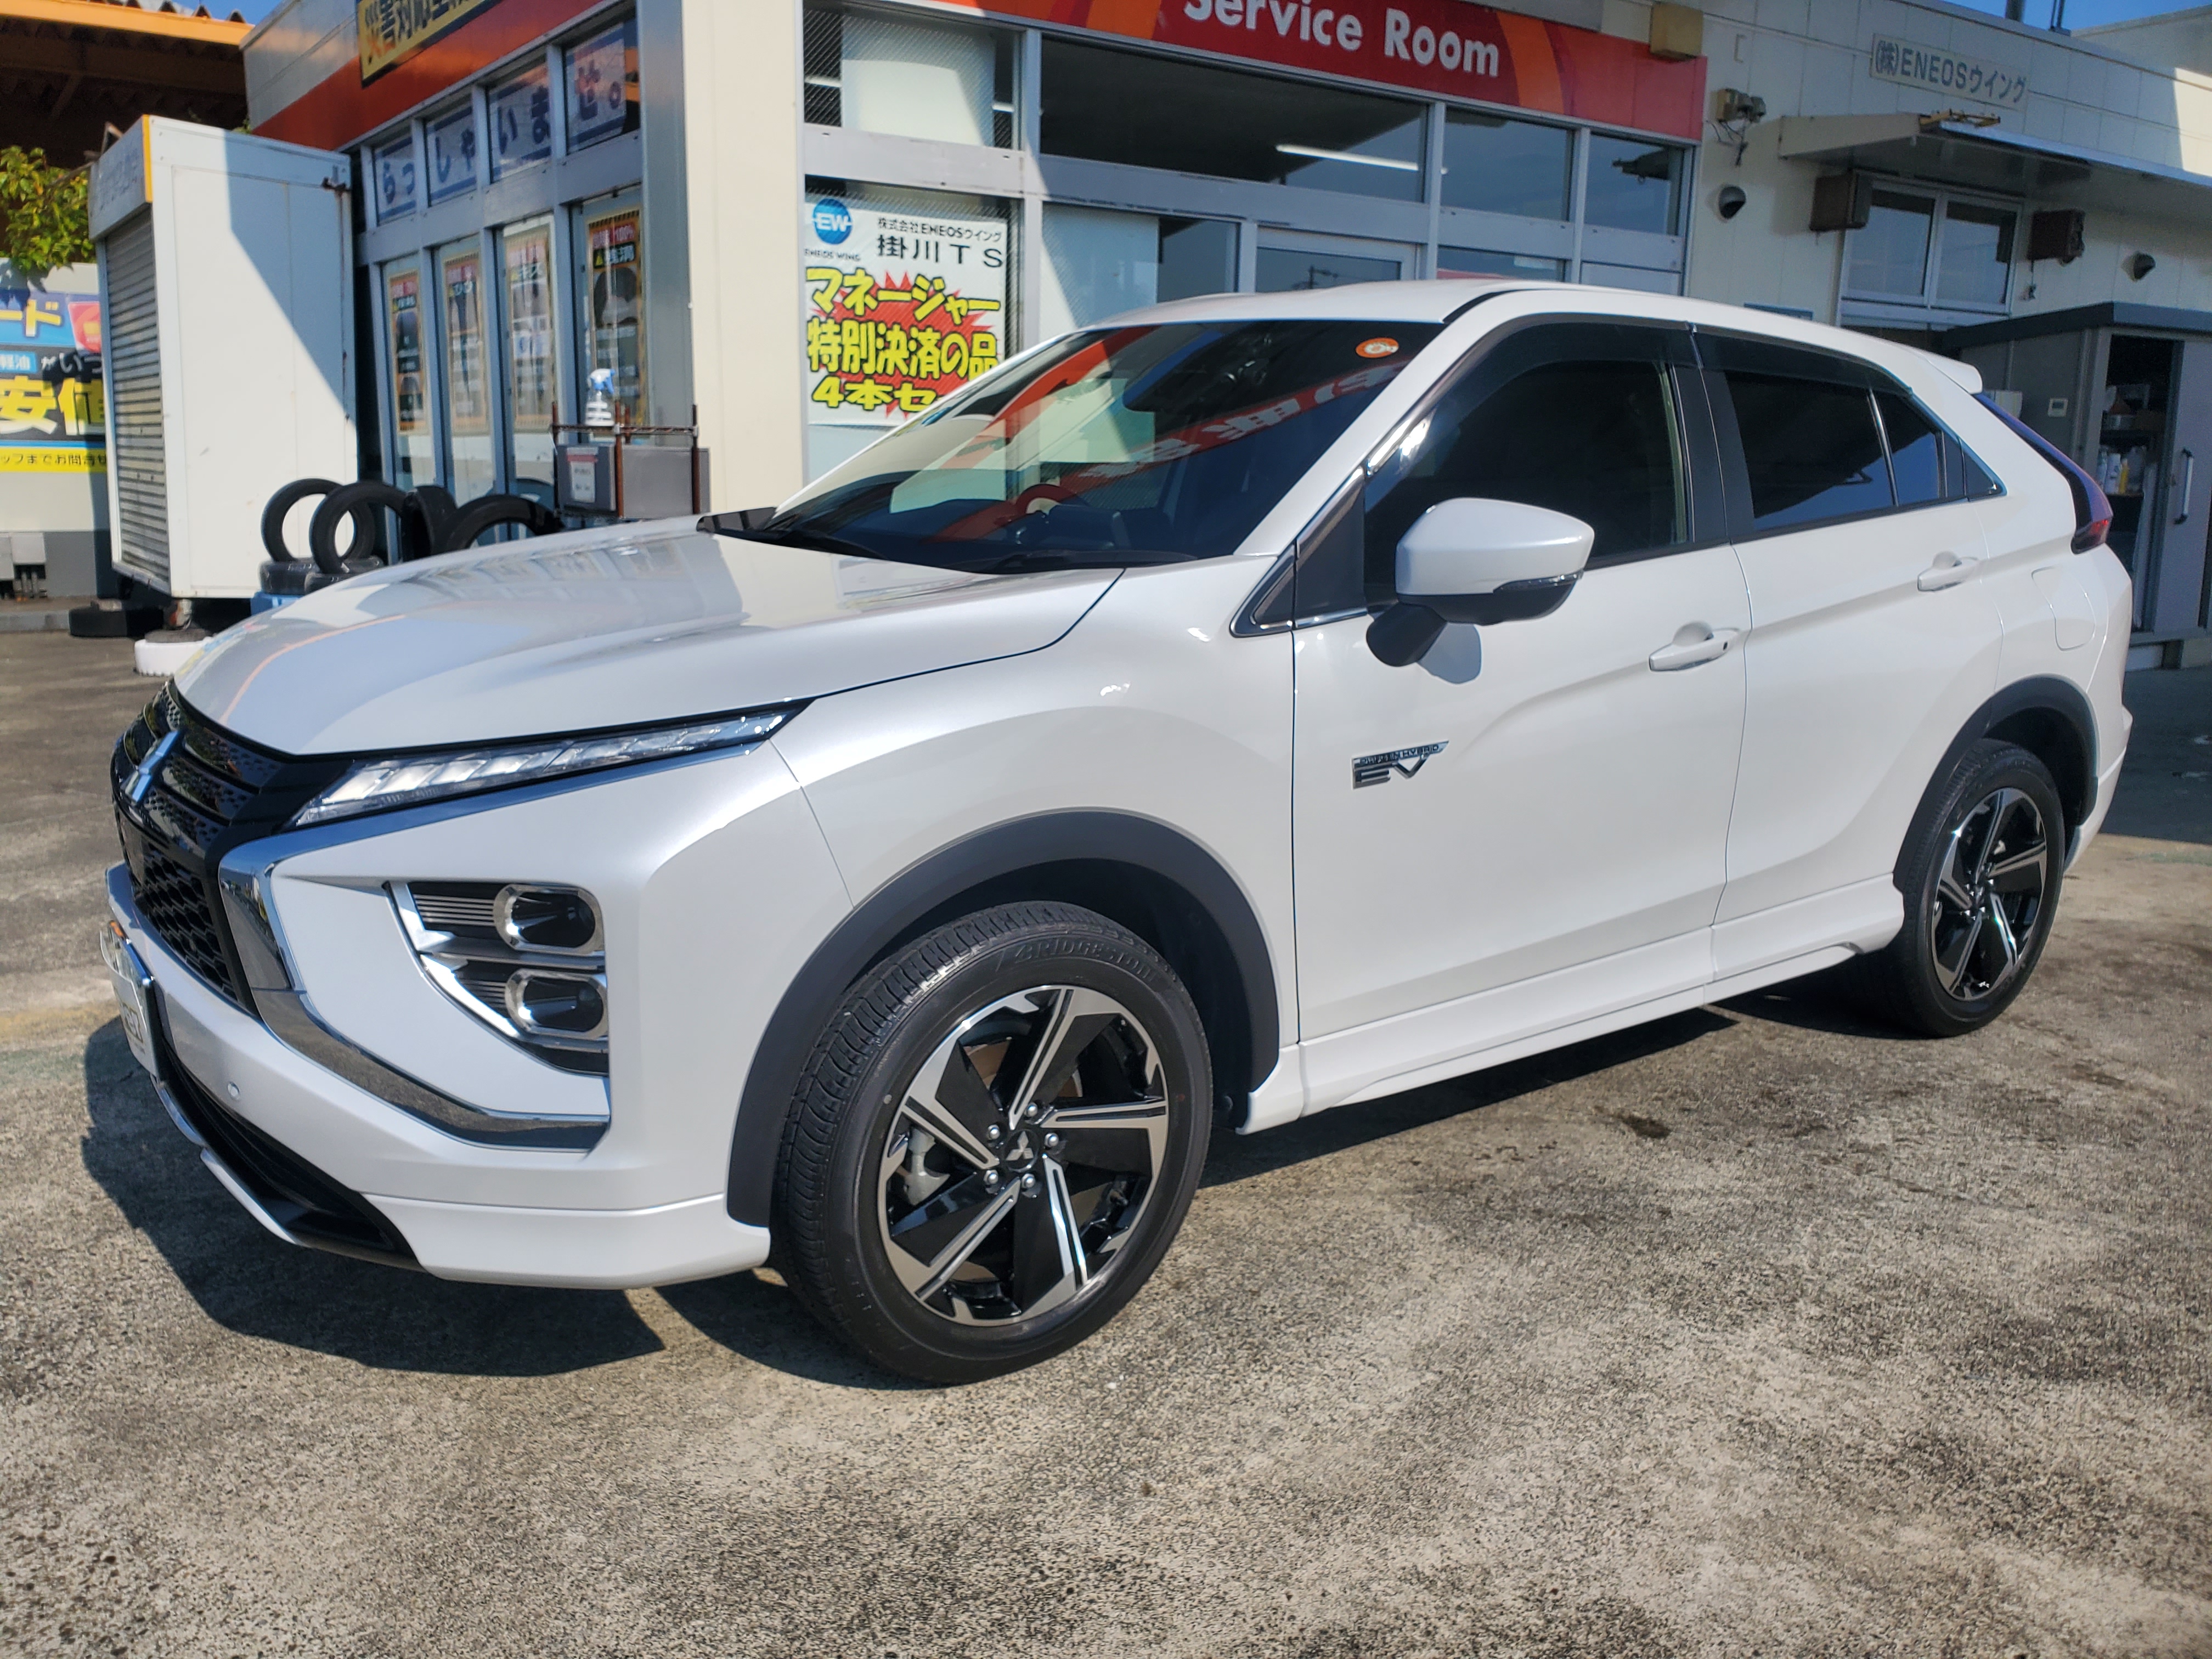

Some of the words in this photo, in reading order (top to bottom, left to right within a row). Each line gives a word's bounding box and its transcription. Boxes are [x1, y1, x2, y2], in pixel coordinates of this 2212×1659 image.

[1385, 8, 1499, 77] Room
[805, 267, 1001, 326] マネージャー
